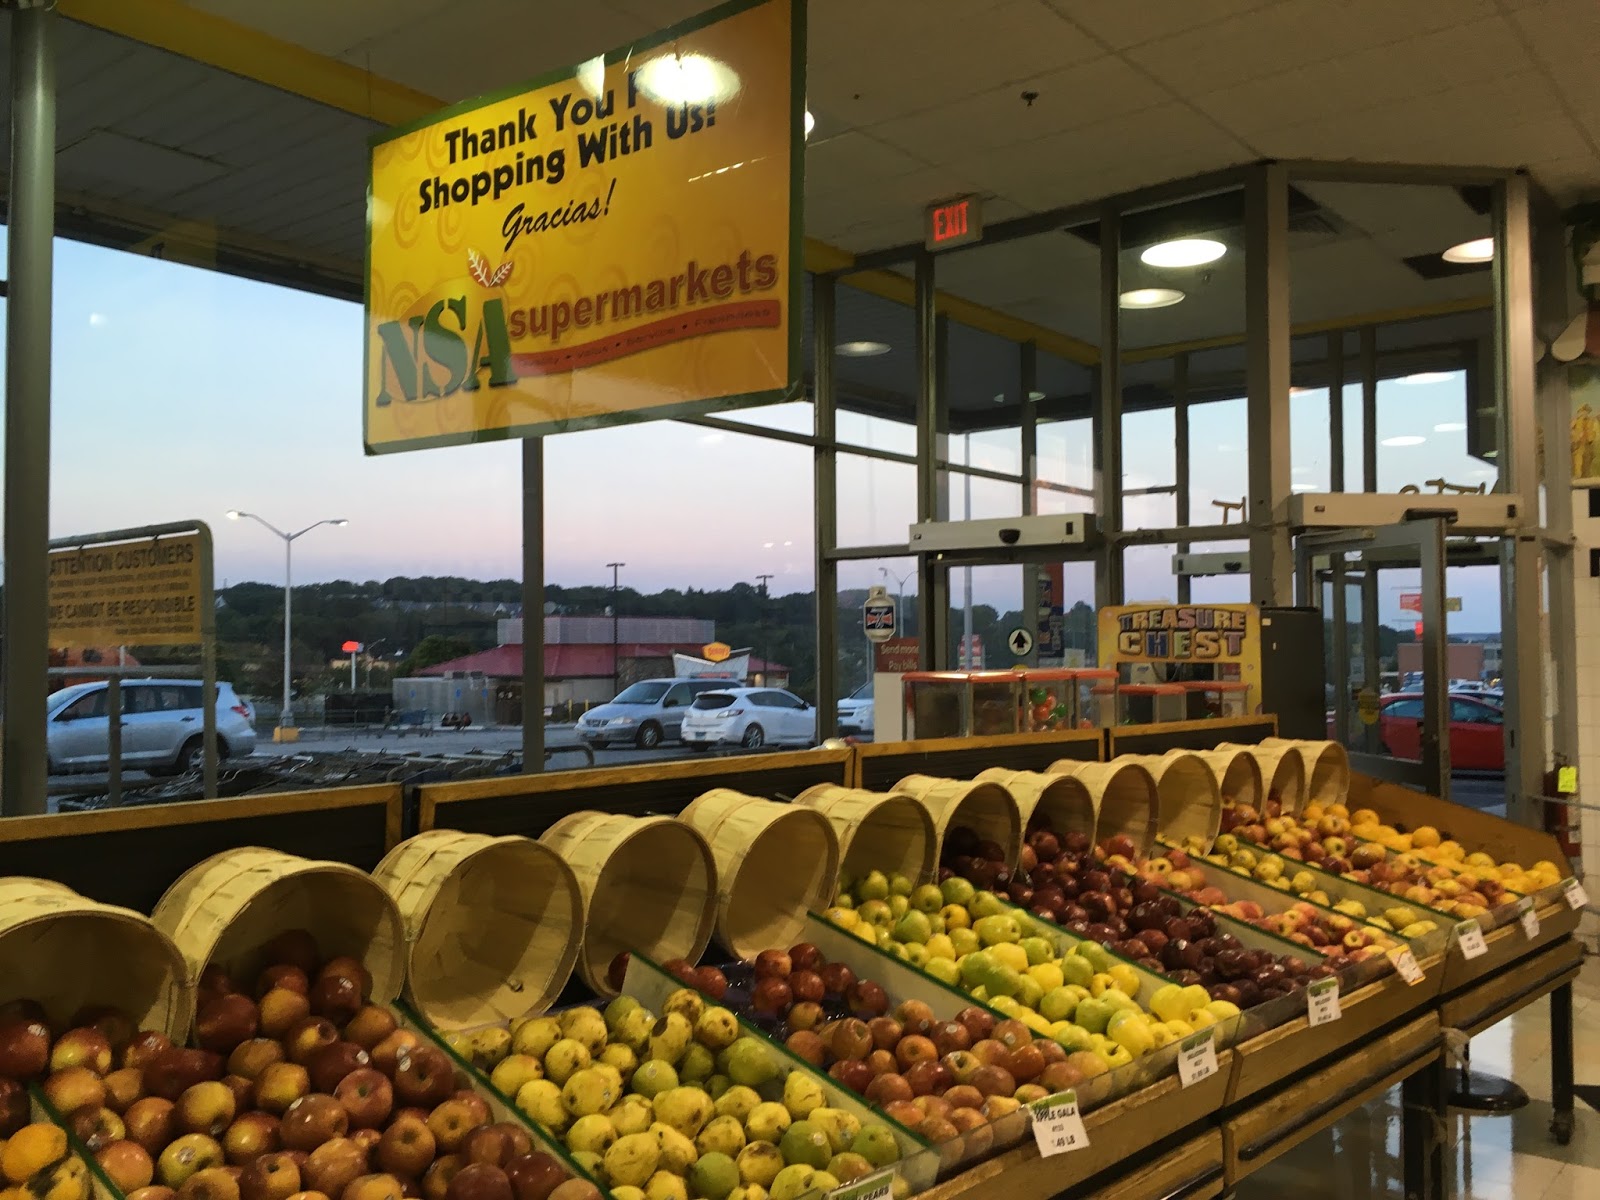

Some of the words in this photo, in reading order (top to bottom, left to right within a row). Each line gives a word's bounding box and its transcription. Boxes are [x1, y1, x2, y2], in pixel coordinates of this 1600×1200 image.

[445, 107, 537, 164] Thank
[549, 89, 614, 132] You
[419, 148, 566, 214] Shopping
[577, 114, 653, 168] With
[666, 96, 717, 140] Us!
[502, 177, 617, 251] Gracias!
[933, 201, 969, 242] EXIT
[509, 250, 778, 341] supermarkets
[376, 295, 518, 407] NSA
[116, 543, 194, 570] CUSTOMERS
[65, 602, 105, 619] CANNOT
[107, 600, 121, 617] BE
[123, 595, 195, 615] RESPONSIBLE
[1117, 607, 1247, 631] TREASURE
[881, 643, 900, 655] Send
[1118, 630, 1246, 659] CHEST
[888, 659, 902, 673] Pay
[1057, 1107, 1075, 1119] GALA
